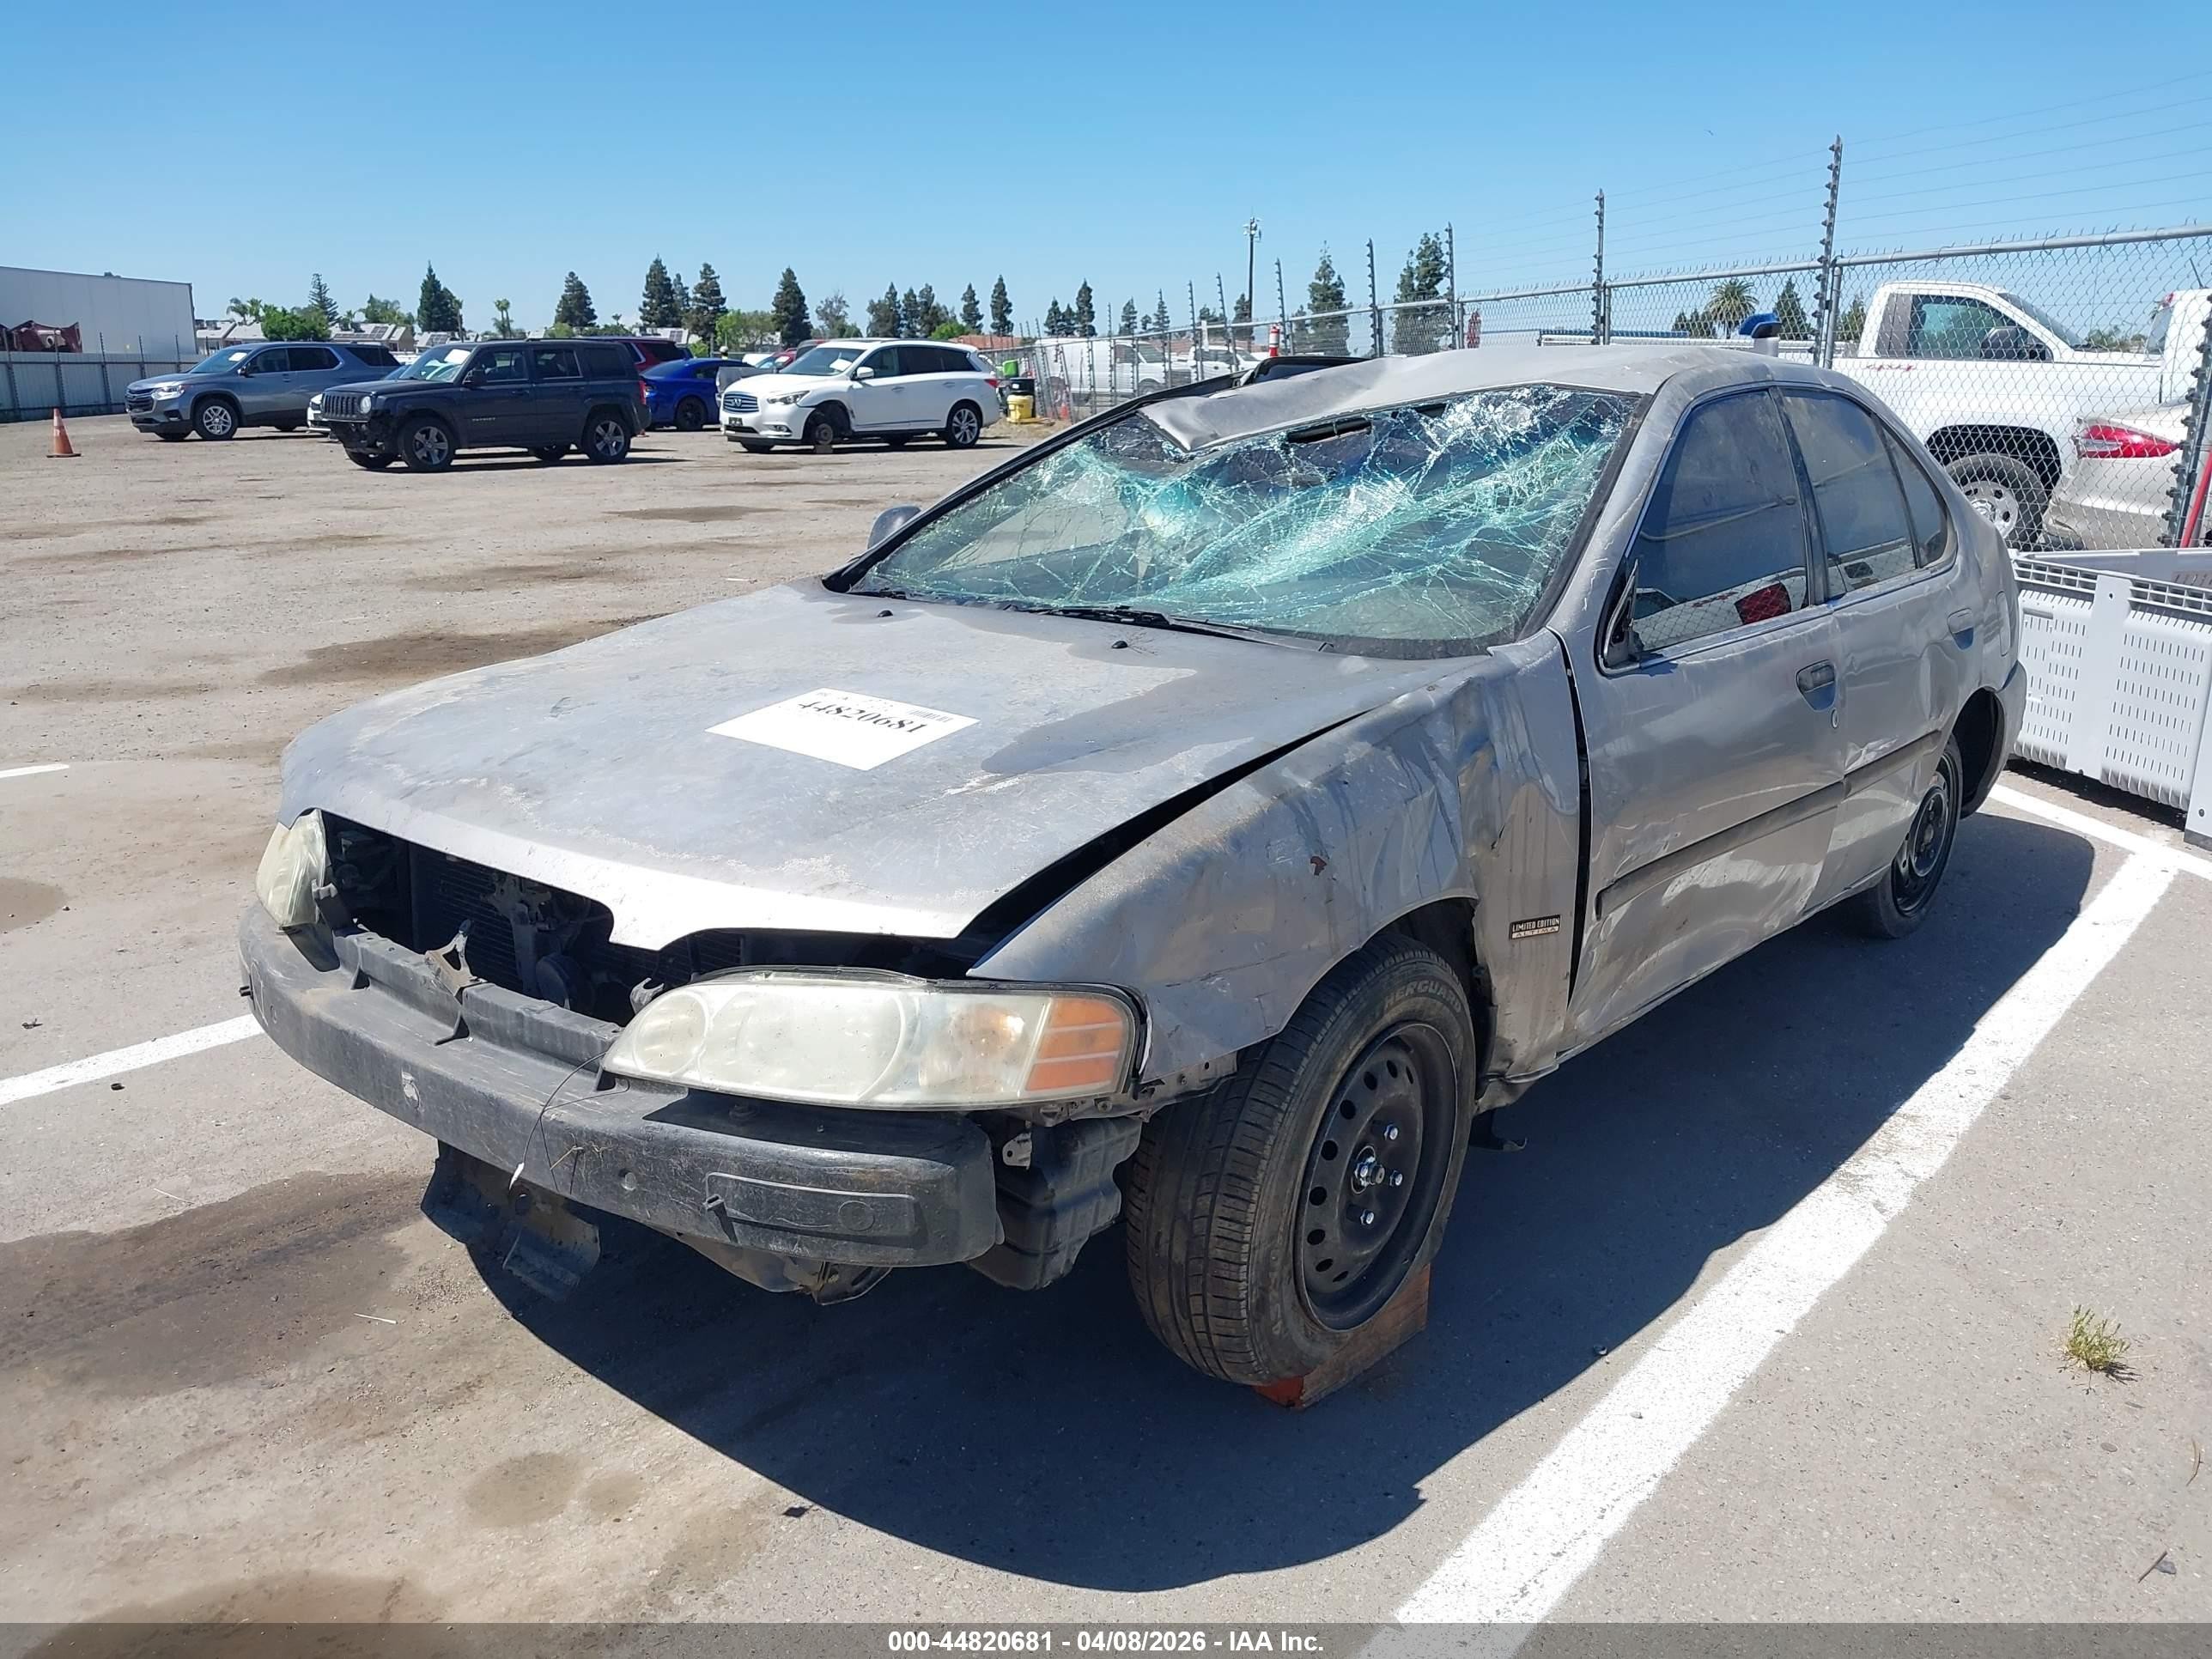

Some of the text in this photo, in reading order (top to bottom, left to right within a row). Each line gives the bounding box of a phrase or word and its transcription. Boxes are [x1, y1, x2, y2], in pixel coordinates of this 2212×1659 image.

[798, 701, 928, 732] 44820681
[1512, 918, 1560, 933] LIMITED EDITION
